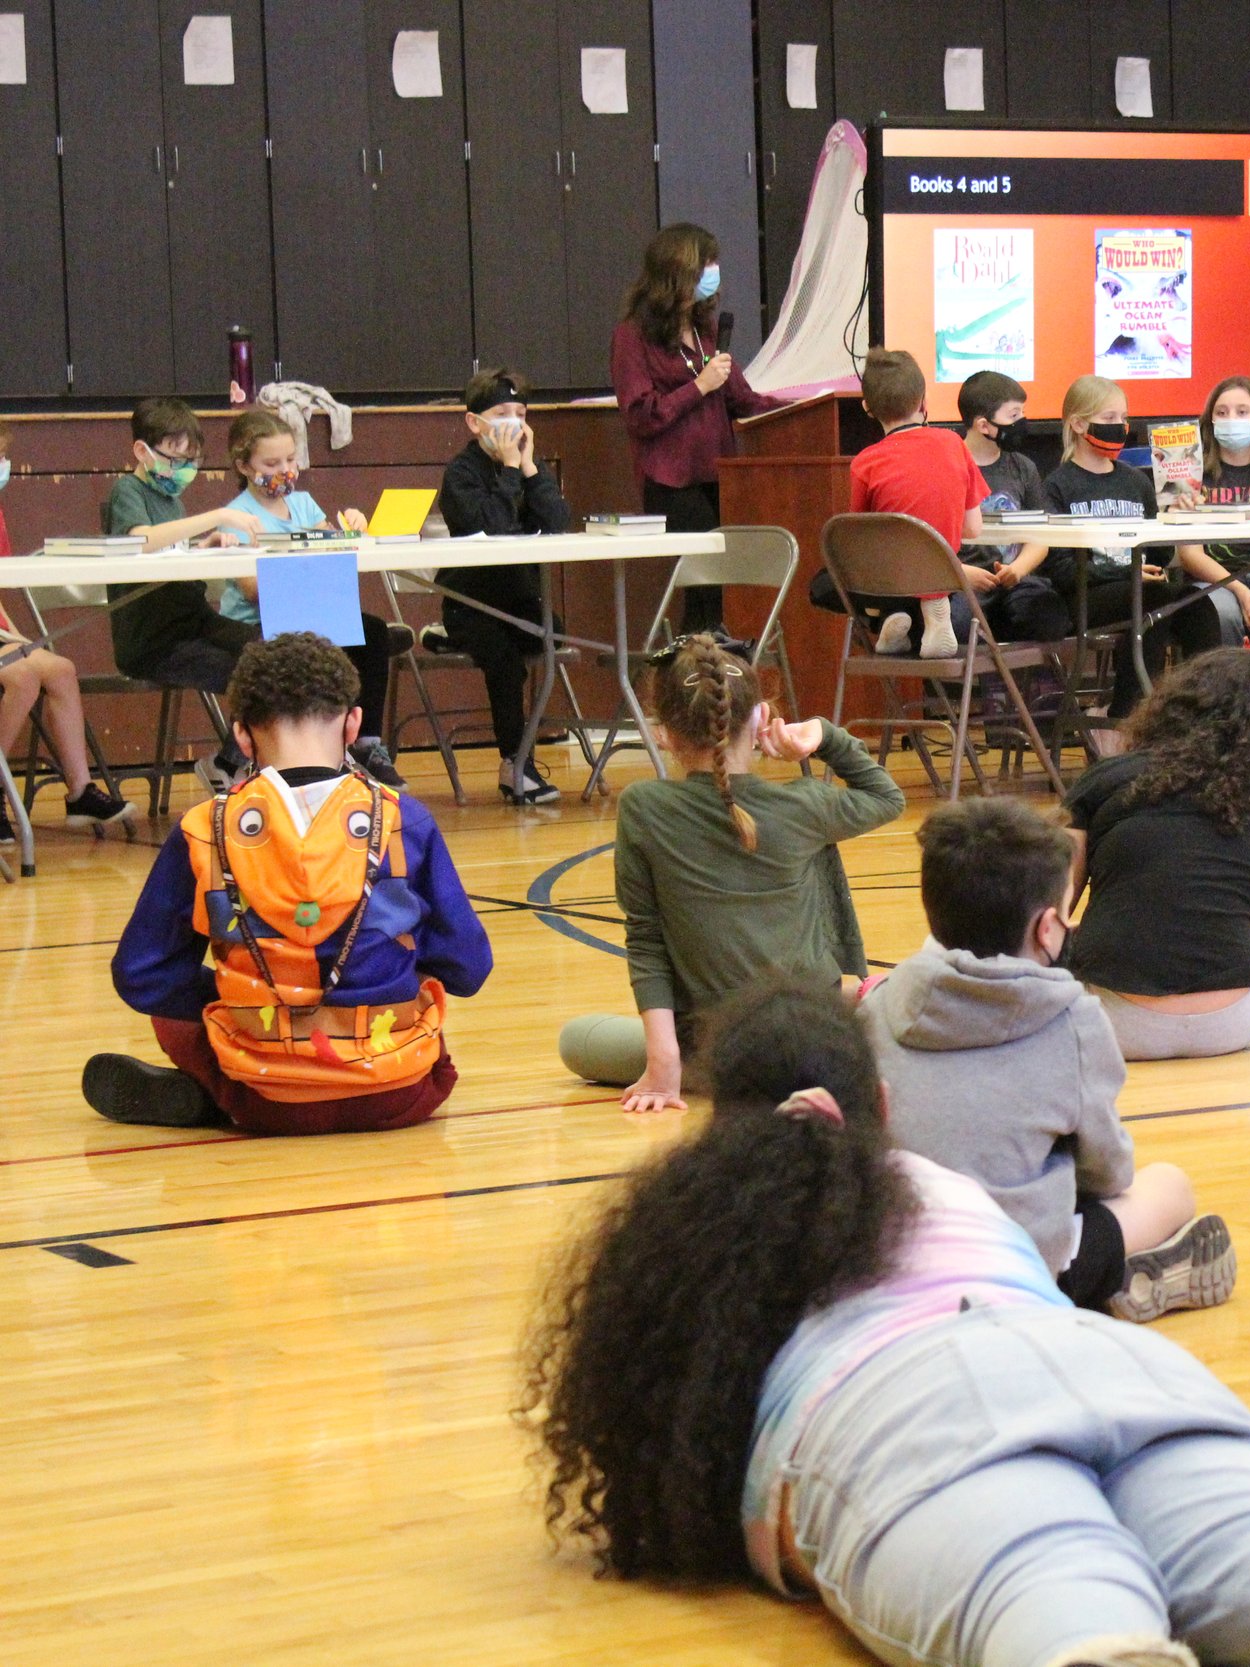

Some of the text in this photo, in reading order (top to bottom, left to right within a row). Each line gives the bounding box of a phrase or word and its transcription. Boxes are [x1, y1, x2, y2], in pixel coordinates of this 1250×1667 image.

[910, 175, 1011, 193] Books 4 and 5
[954, 235, 1014, 263] Roald
[1132, 240, 1155, 248] WHO
[1104, 246, 1183, 269] WOULD WIN?
[961, 260, 1011, 284] Dahl
[1113, 300, 1174, 310] ULTIMATE
[1124, 311, 1163, 320] OCEAN
[1120, 322, 1168, 331] RUMBLE
[1153, 433, 1177, 446] WOULD
